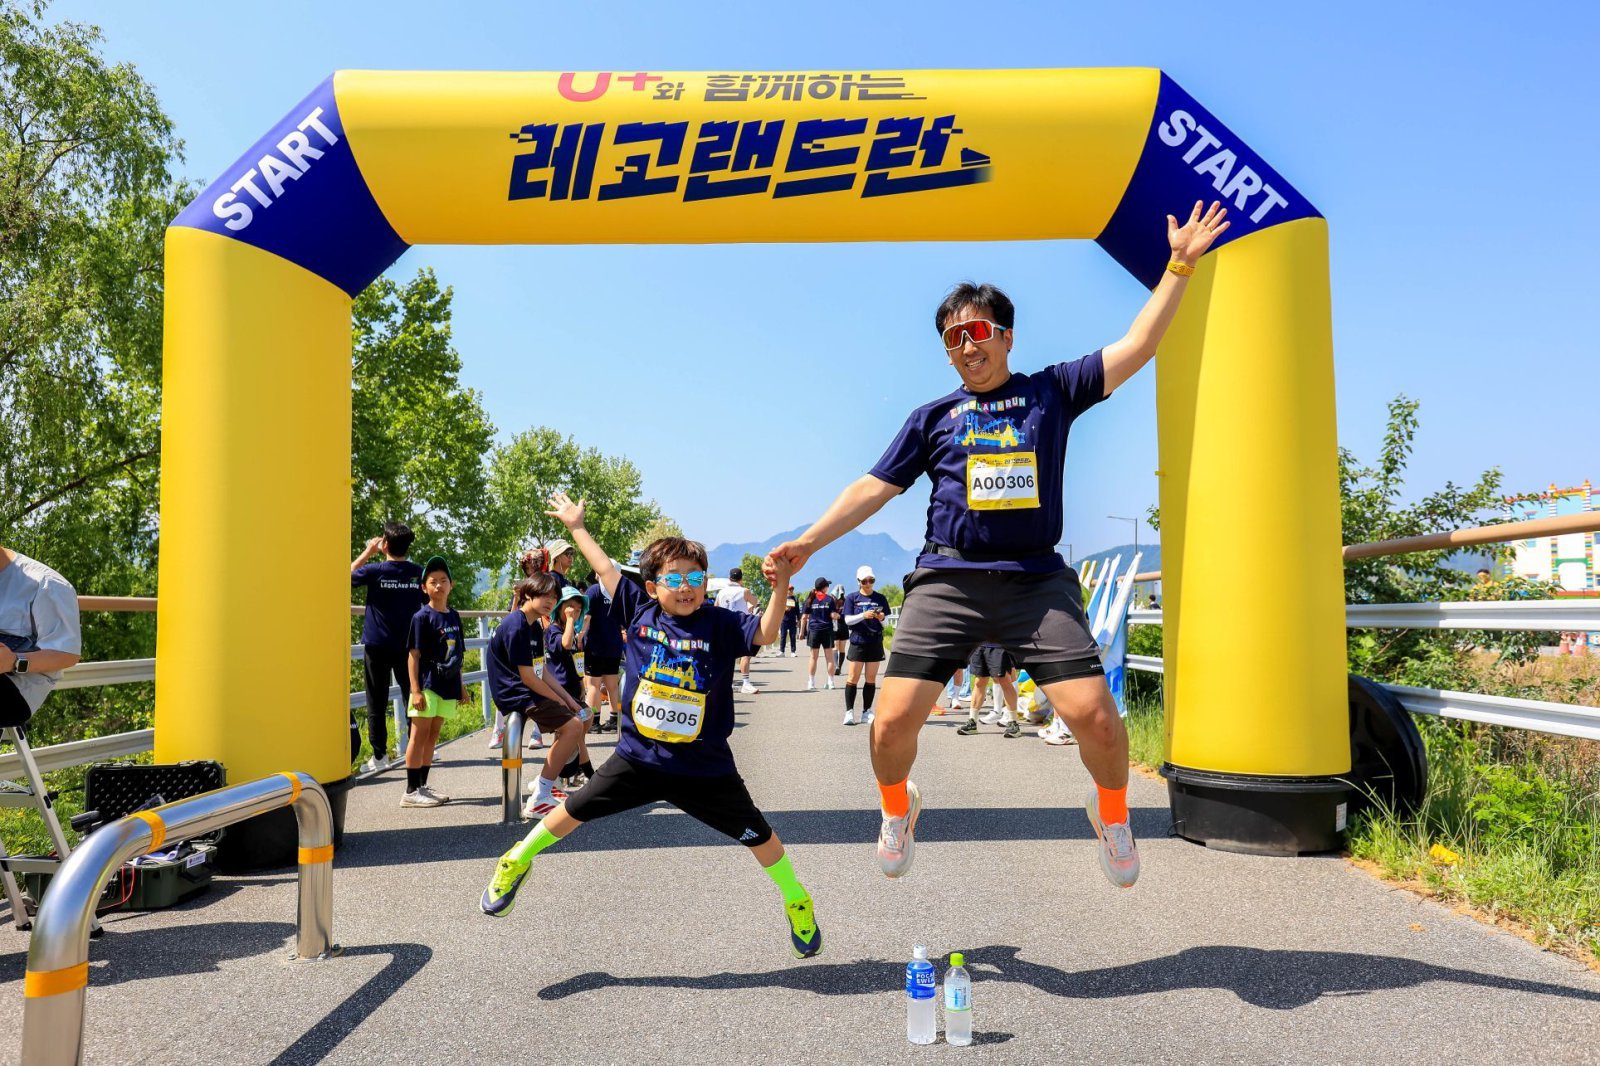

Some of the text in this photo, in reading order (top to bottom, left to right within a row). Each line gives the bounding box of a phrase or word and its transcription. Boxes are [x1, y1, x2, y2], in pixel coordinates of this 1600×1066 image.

[703, 74, 927, 102] 함께하는
[212, 106, 339, 231] START
[507, 114, 995, 202] 레고랜드런
[1158, 109, 1289, 224] START
[972, 475, 1035, 490] A00306
[635, 702, 698, 727] A00305
